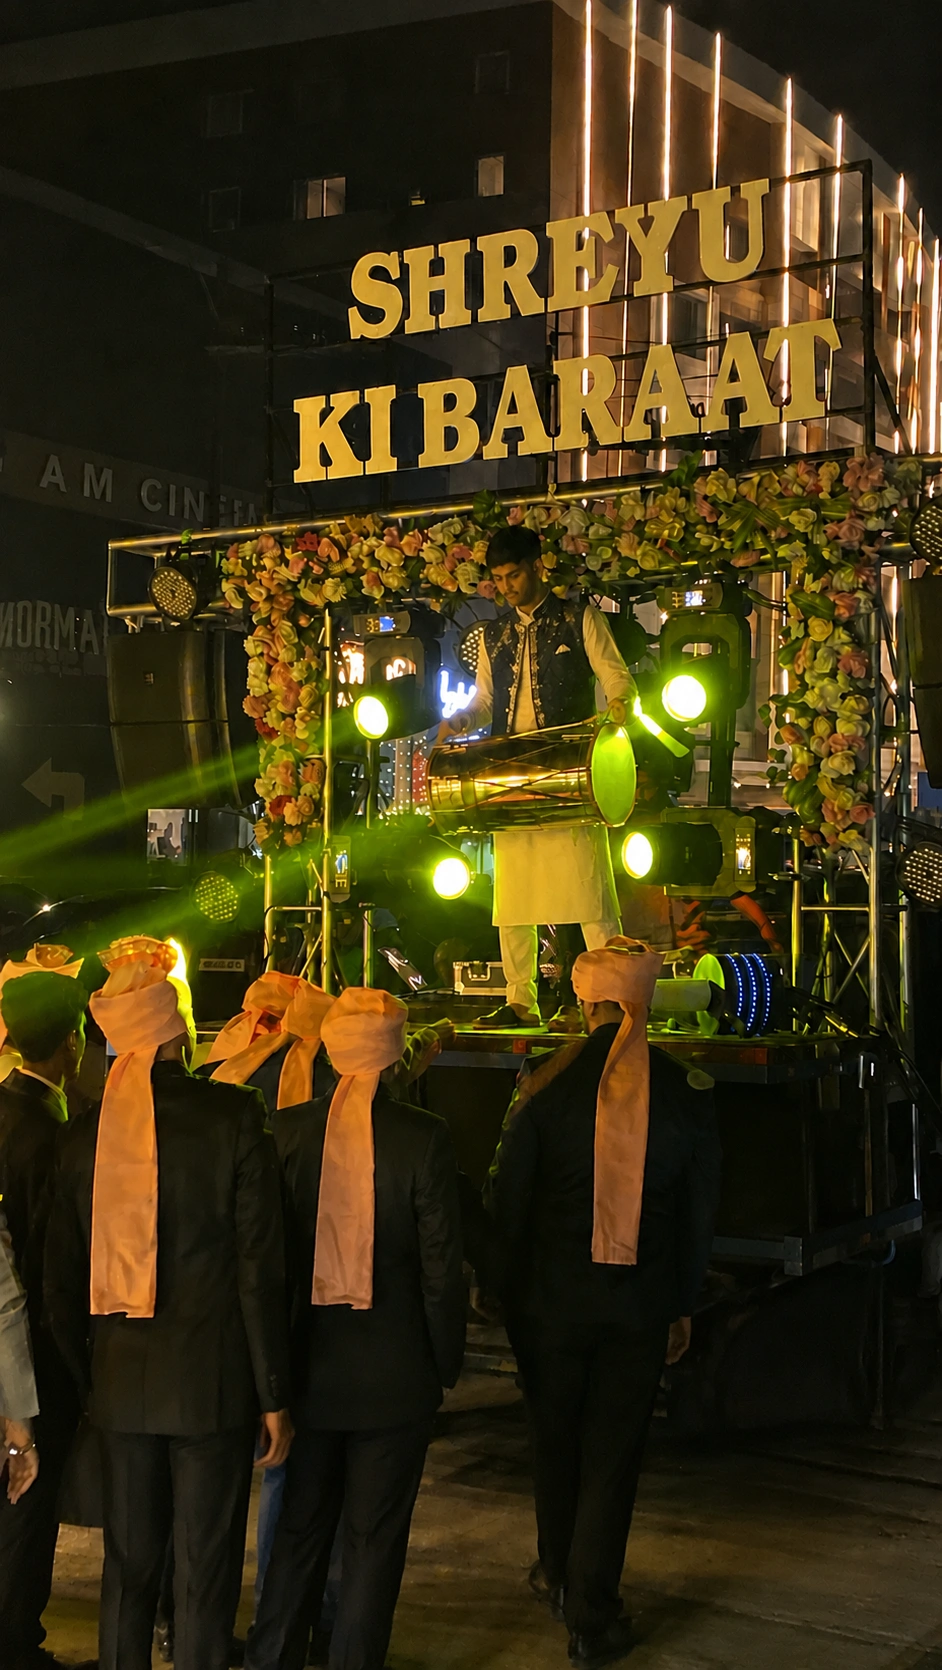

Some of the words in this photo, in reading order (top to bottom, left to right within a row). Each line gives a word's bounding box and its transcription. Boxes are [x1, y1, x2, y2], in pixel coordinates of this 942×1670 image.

[348, 178, 770, 340] SHREYU
[293, 384, 398, 484] KI
[418, 318, 842, 468] BARAAT
